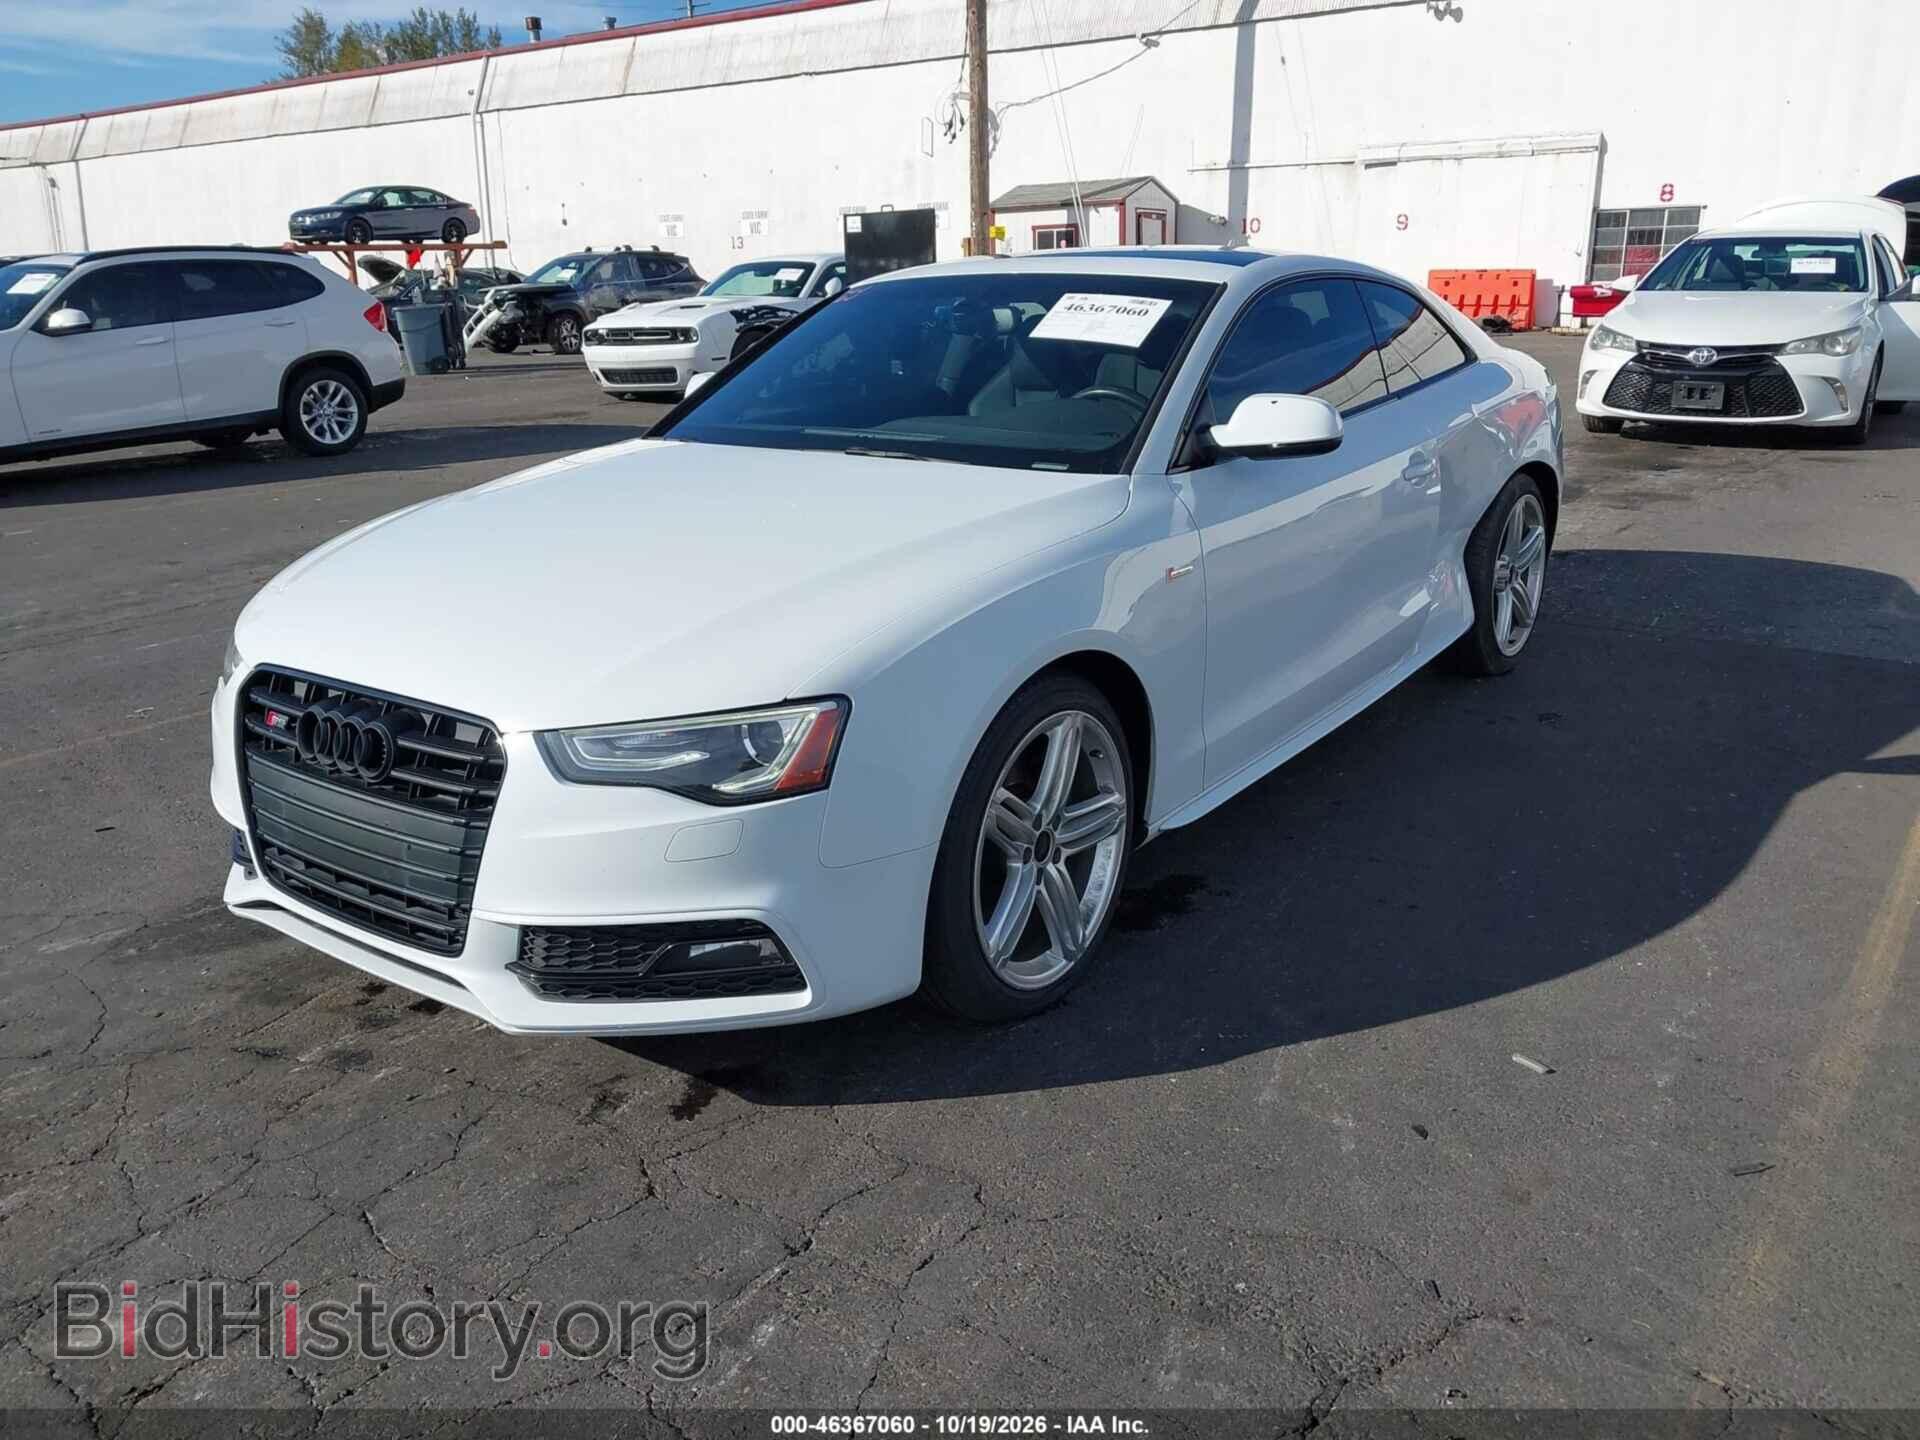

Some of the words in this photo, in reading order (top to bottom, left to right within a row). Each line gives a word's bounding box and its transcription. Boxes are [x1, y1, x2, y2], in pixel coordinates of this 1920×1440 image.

[1660, 183, 1674, 202] 8
[1241, 217, 1261, 234] 10
[1396, 213, 1409, 231] 9
[730, 236, 744, 249] 13
[1063, 303, 1149, 317] 46367060
